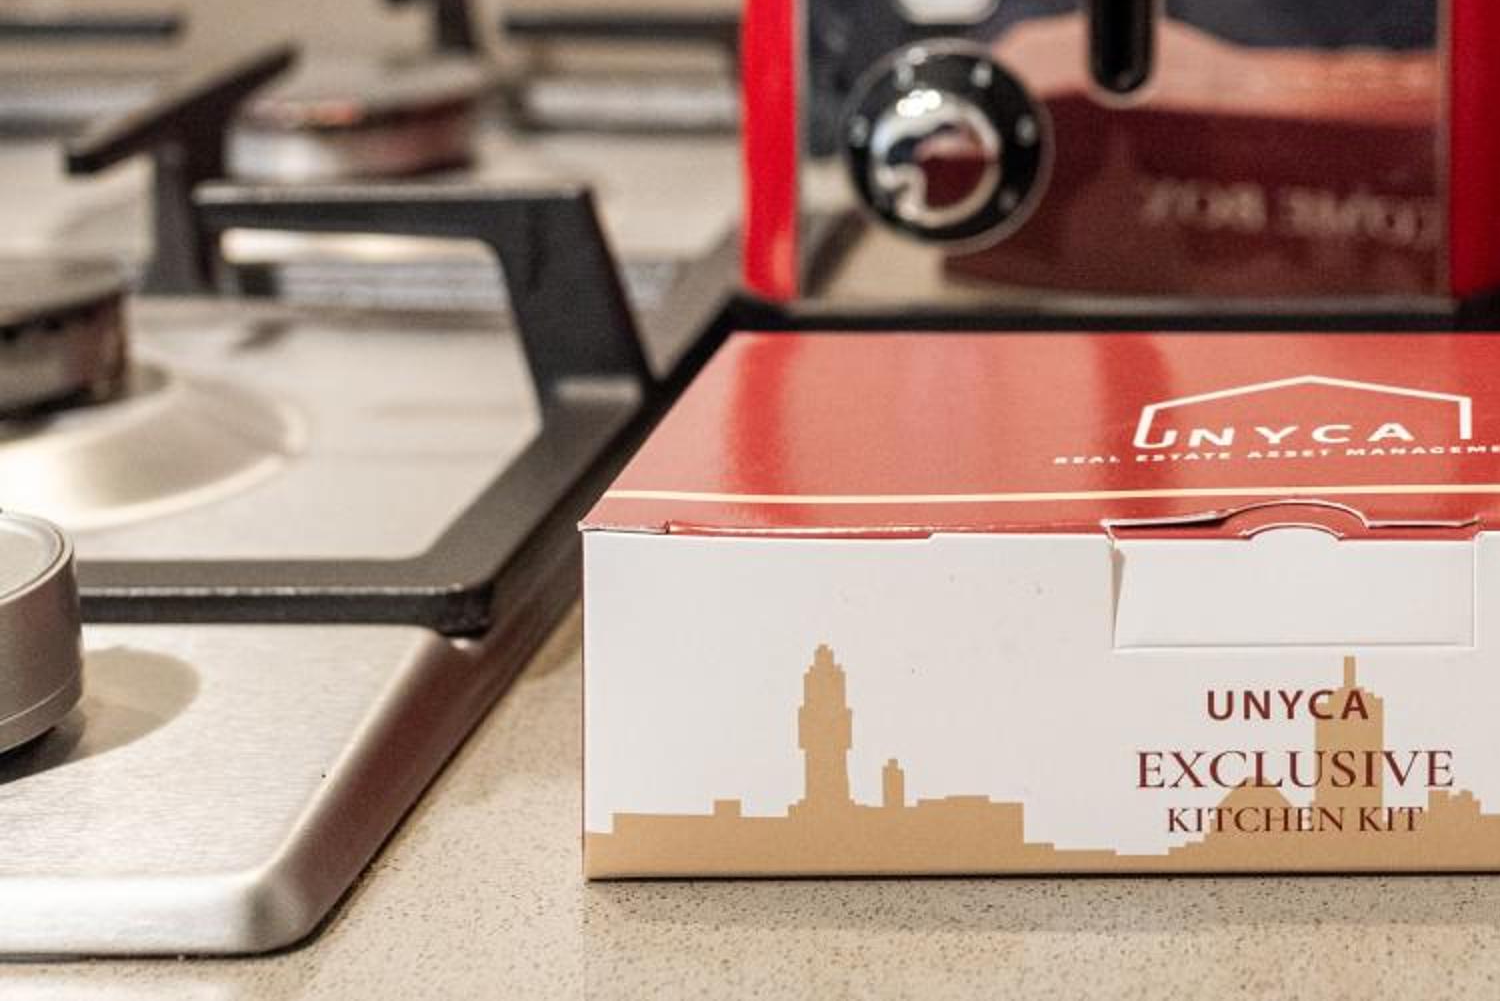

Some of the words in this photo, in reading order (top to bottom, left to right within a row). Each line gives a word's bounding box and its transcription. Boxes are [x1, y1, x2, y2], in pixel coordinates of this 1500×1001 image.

[1133, 422, 1414, 449] UNYCA
[1053, 455, 1121, 465] REAL
[1135, 451, 1239, 462] ESTATE
[1247, 447, 1331, 459] ASSET
[1206, 689, 1369, 721] UNYCA
[1135, 749, 1455, 790] EXCLUSIVE
[1167, 805, 1345, 834] KITCHEN
[1357, 805, 1424, 833] KIT
